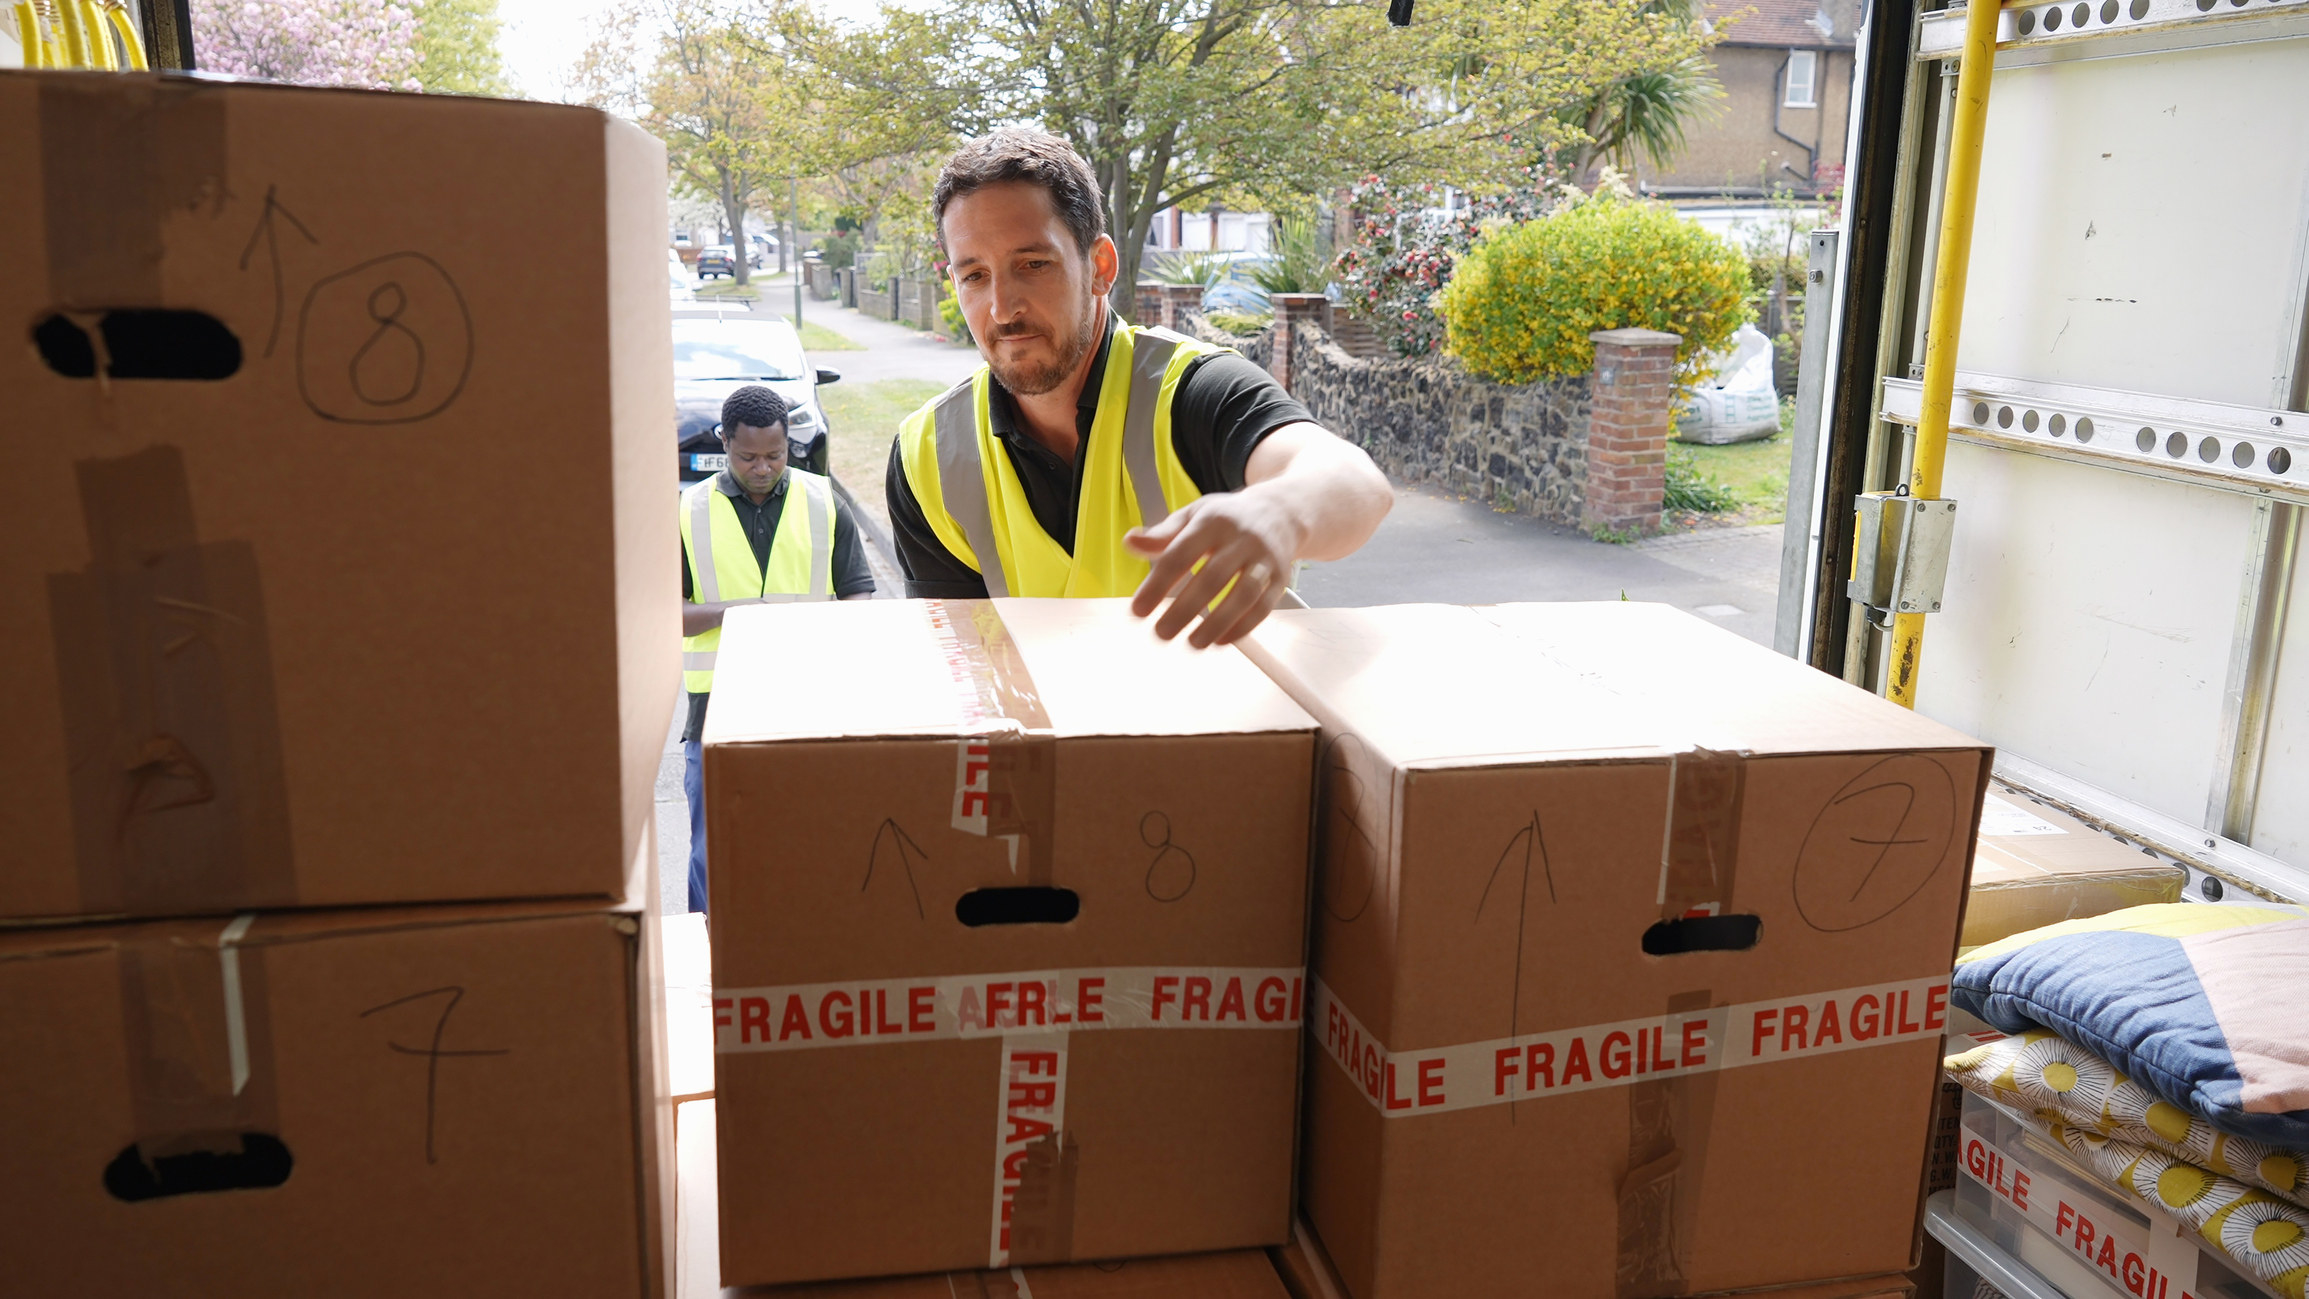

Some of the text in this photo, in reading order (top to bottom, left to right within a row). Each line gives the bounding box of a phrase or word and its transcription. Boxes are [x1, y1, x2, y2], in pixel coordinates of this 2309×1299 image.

[349, 281, 426, 407] 8
[1140, 810, 1196, 903] 8
[1834, 782, 1929, 902] 7
[714, 986, 936, 1044] FRAGILE
[1328, 1001, 1445, 1110] FRAGILE
[1495, 1020, 1708, 1096] FRAGILE
[1752, 984, 1947, 1056] FRAGILE
[359, 985, 511, 1166] 7
[2056, 1200, 2195, 1299] FRAGI
